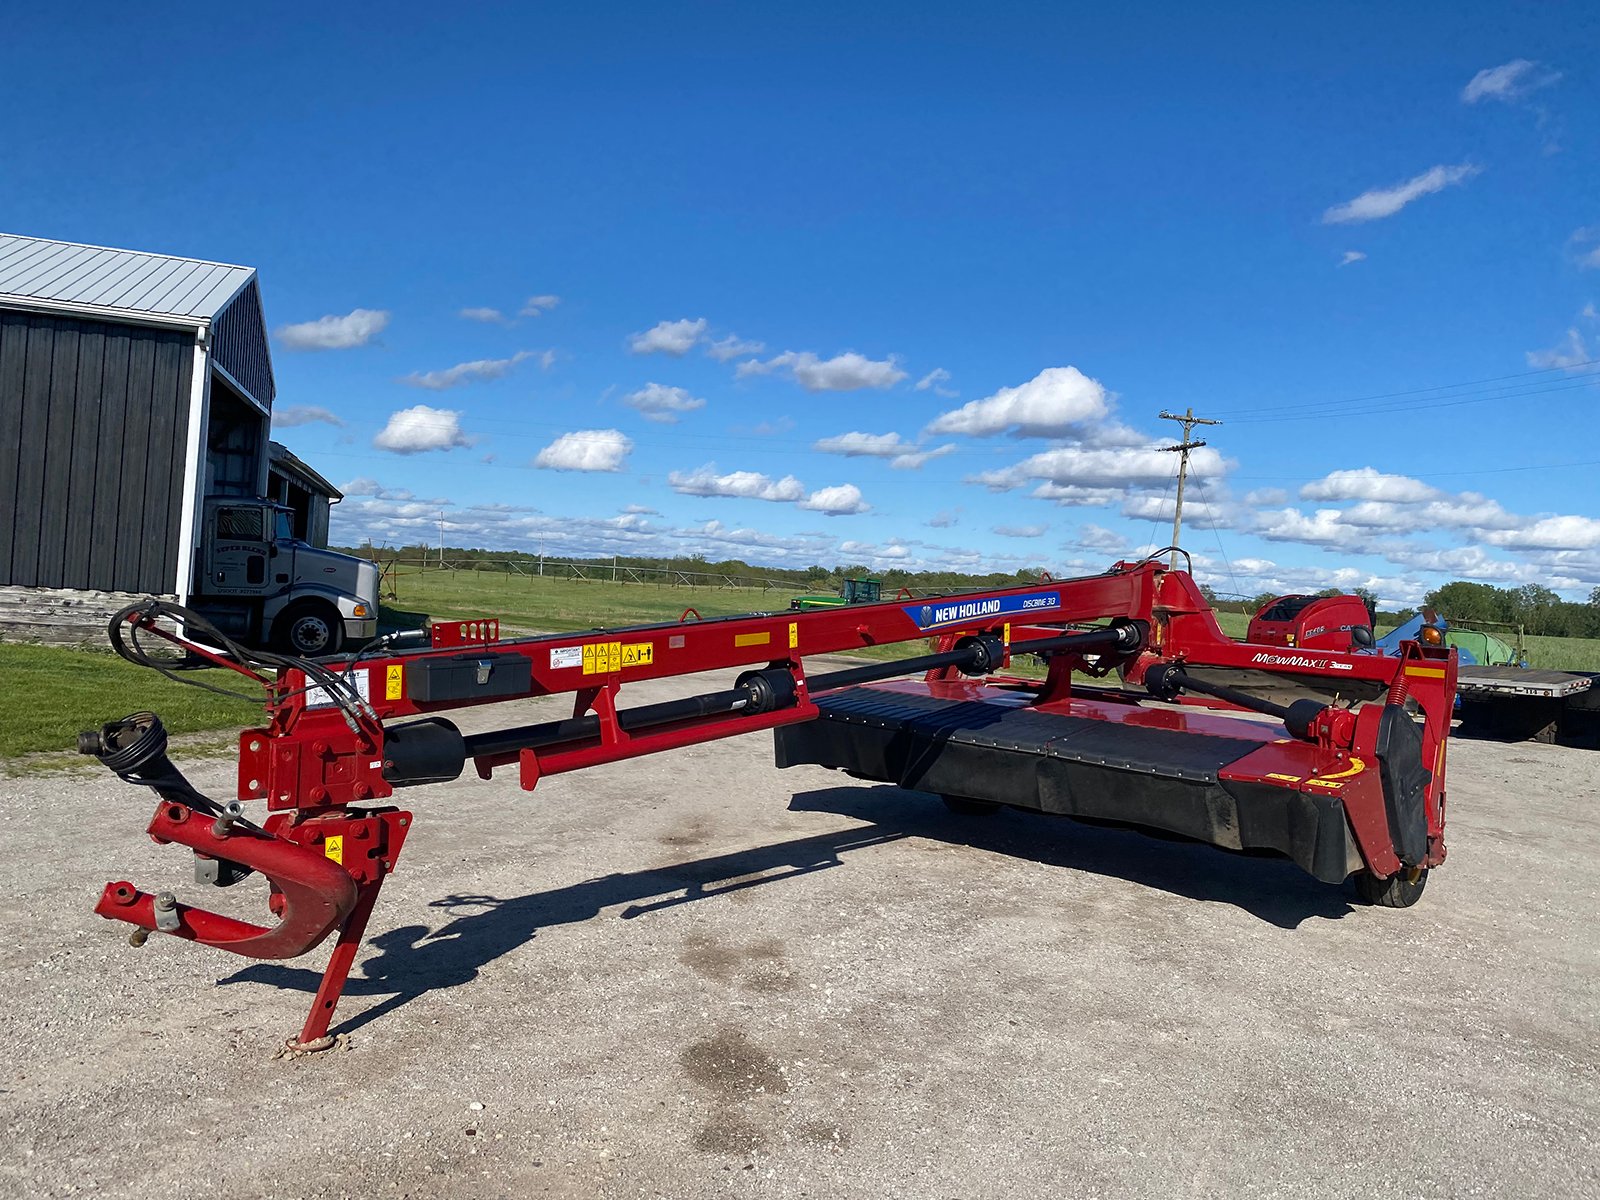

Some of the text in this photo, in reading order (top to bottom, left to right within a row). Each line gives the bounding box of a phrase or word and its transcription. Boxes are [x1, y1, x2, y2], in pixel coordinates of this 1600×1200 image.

[935, 597, 1056, 622] NEW HOLLAND DISCBINE 313
